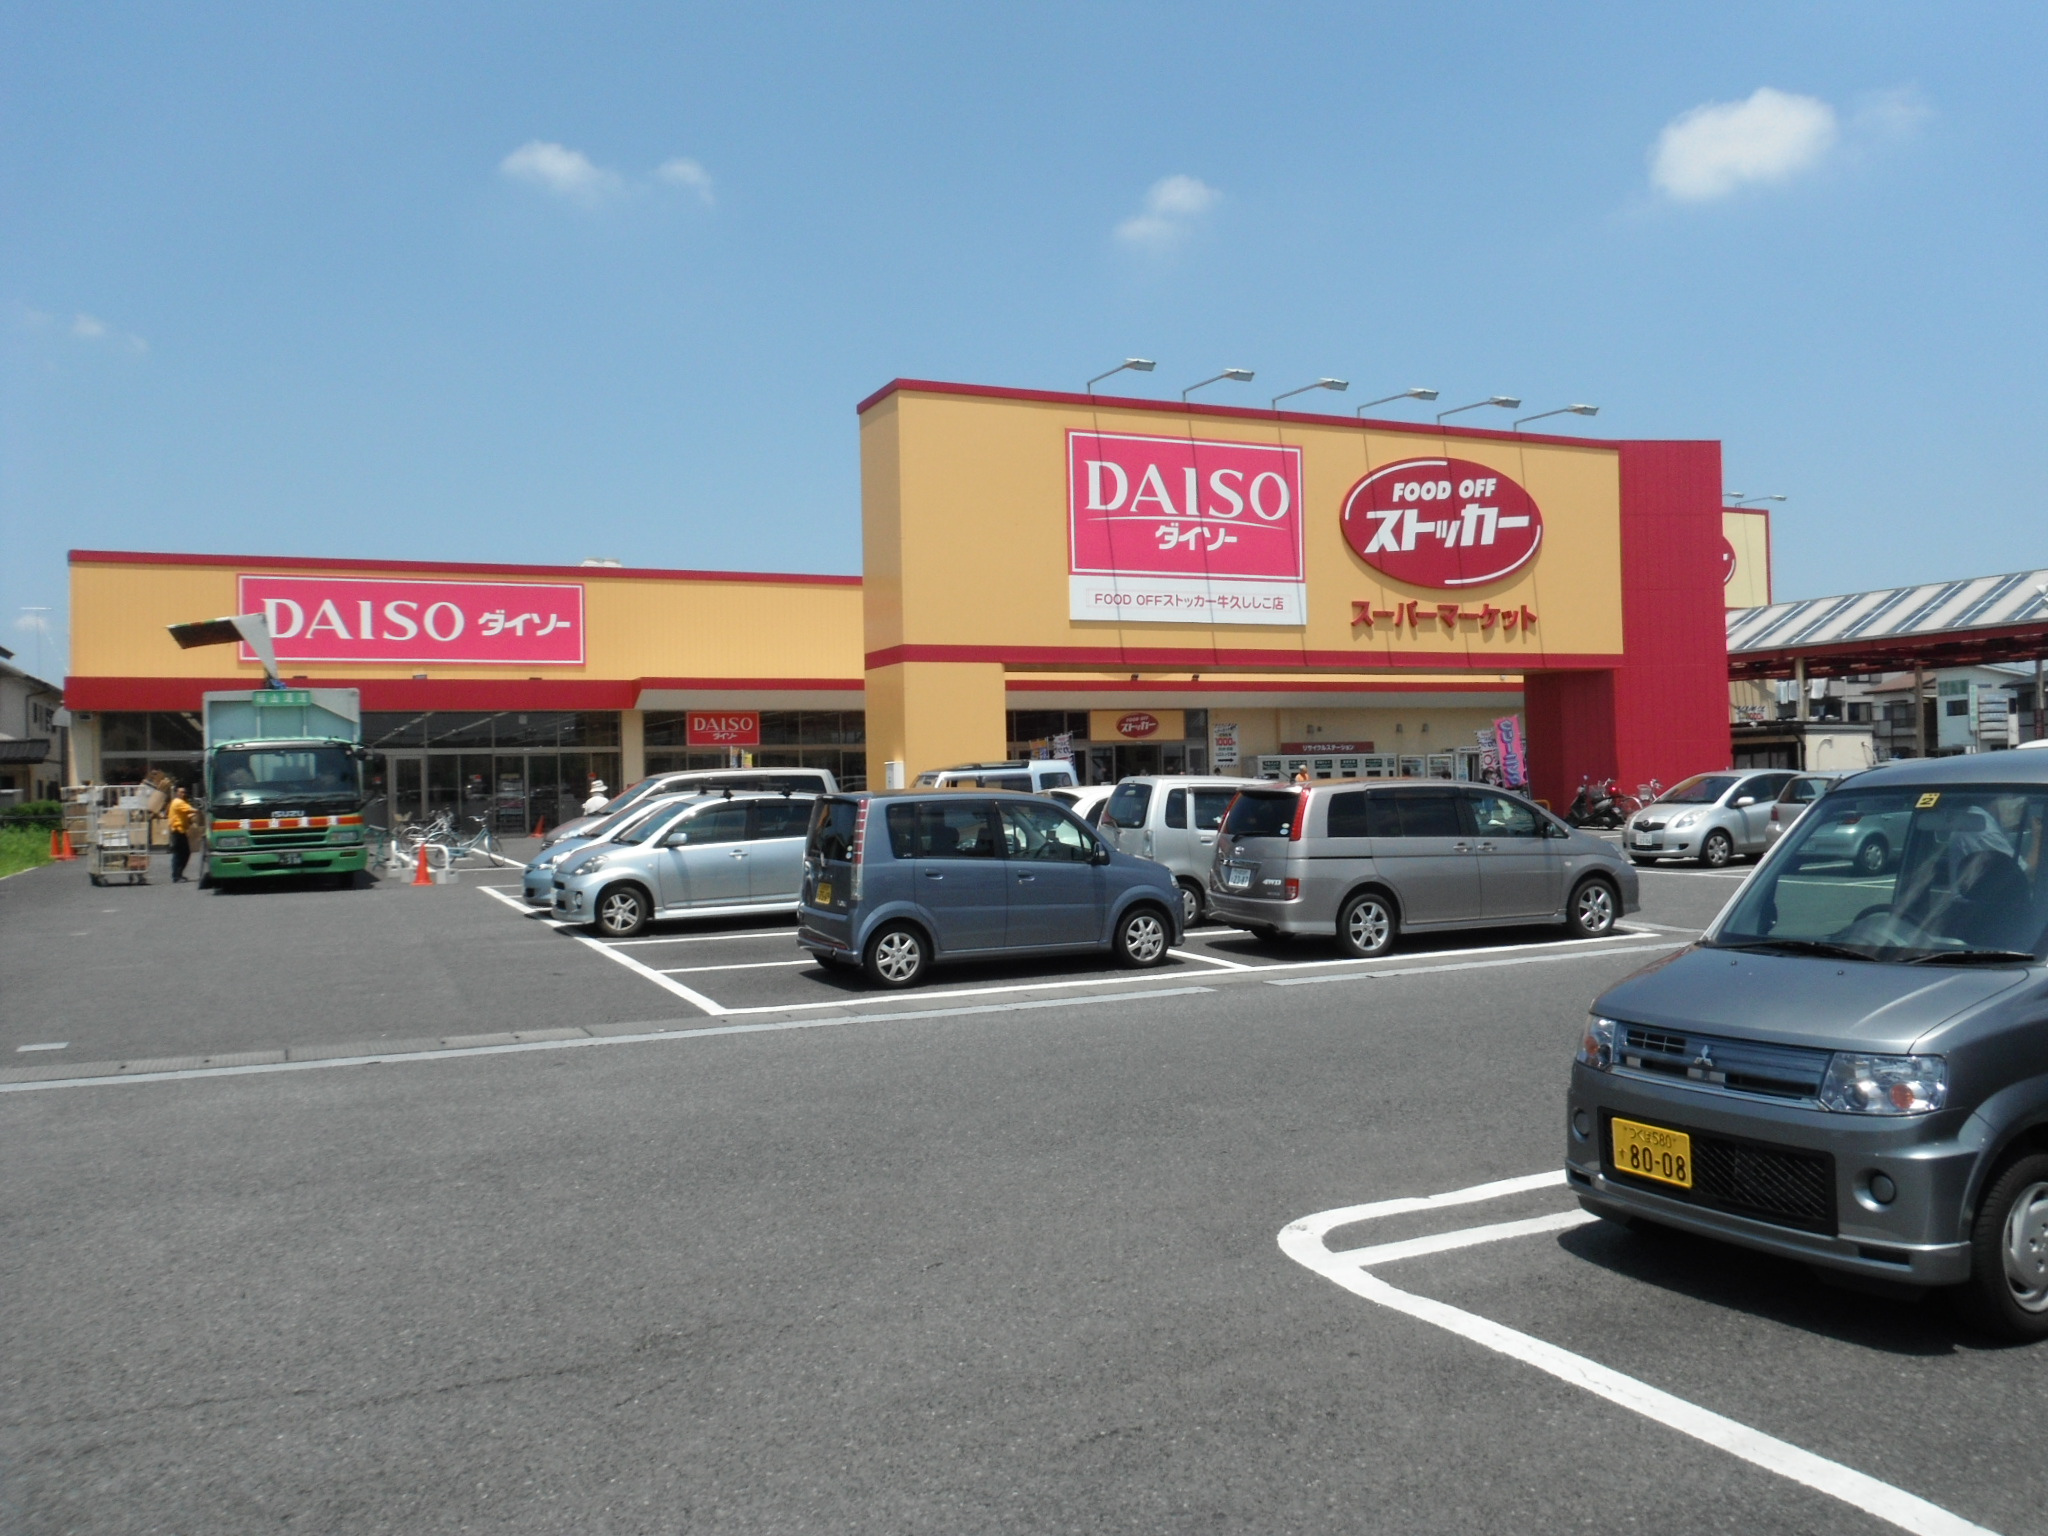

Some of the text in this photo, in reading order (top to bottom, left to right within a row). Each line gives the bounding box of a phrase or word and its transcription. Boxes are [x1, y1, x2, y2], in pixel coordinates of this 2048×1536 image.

[1083, 460, 1291, 521] DAISO
[1392, 478, 1498, 502] FOOD OFF
[1155, 522, 1238, 551] ダイソー
[1364, 503, 1530, 554] ストッカー
[1094, 593, 1132, 605] FOOD
[261, 598, 571, 642] DAISO ダイソー
[1350, 600, 1538, 632] スーパーマーケット
[693, 717, 754, 731] DAISO
[1120, 721, 1157, 733] ストッカー
[1302, 744, 1355, 752] リサイクルステーション
[271, 810, 305, 818] ISUZU
[1630, 1143, 1687, 1181] 80-08
